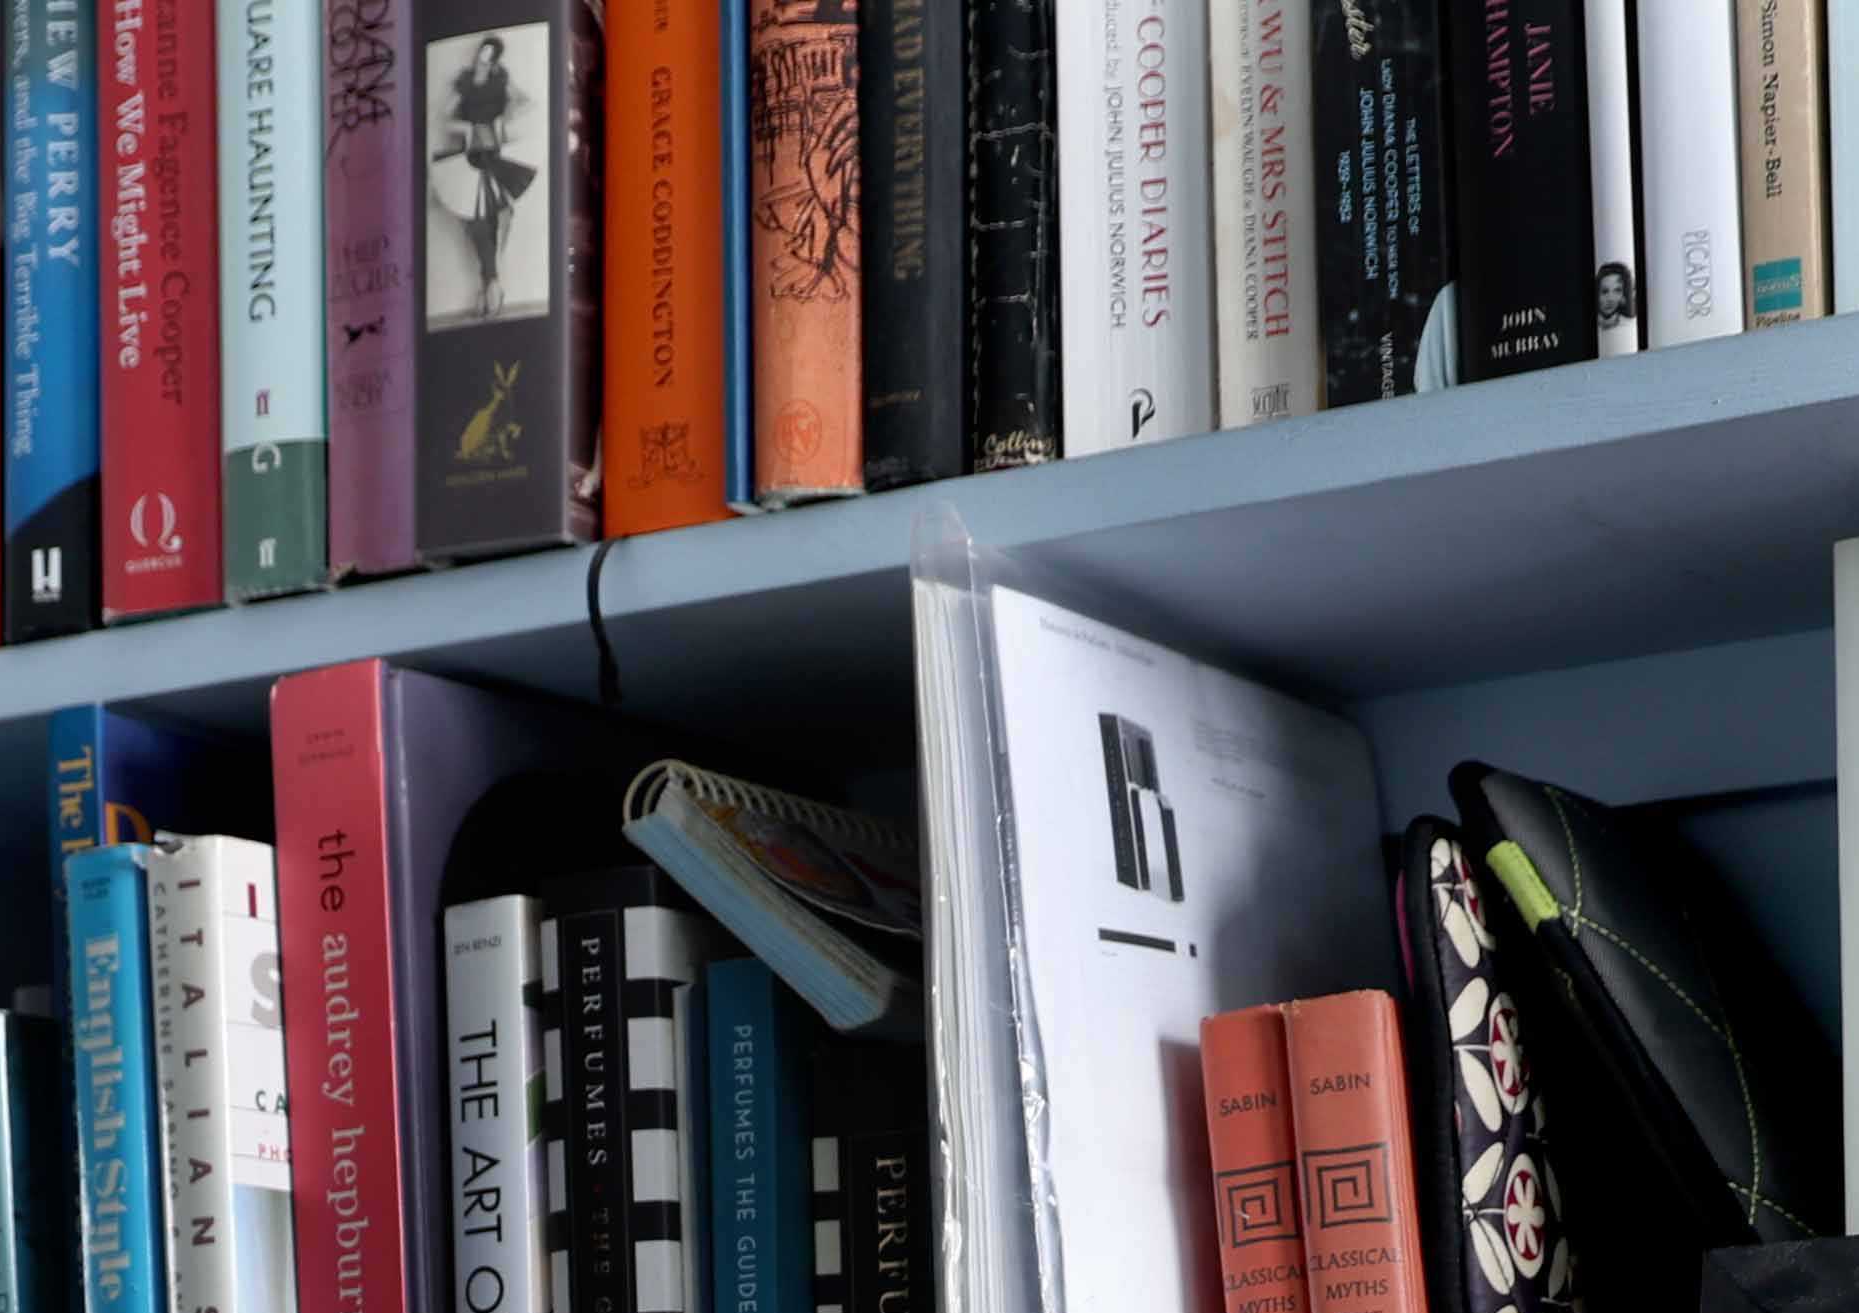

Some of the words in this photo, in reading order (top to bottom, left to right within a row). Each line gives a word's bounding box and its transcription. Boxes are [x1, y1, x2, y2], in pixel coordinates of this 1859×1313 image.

[114, 0, 143, 88] How
[1138, 15, 1167, 166] COOPER
[117, 94, 143, 155] We
[651, 65, 674, 172] GRACE
[46, 112, 81, 266] PERRY
[111, 163, 148, 278] Might
[247, 111, 276, 322] HAUNTING
[651, 178, 675, 390] CODDINGTON
[1141, 178, 1170, 329] DIARIES
[119, 284, 143, 368] Live
[319, 830, 353, 911] the
[79, 930, 125, 1151] English
[320, 931, 361, 1108] audrey
[460, 1020, 498, 1122] THE
[733, 1023, 754, 1161] PERFUMES
[1218, 1093, 1277, 1117] SABIN
[1309, 1073, 1371, 1096] SABIN
[91, 1157, 133, 1303] Style
[464, 1147, 501, 1242] ART
[736, 1172, 754, 1222] THE
[1326, 1276, 1389, 1300] MYTHS
